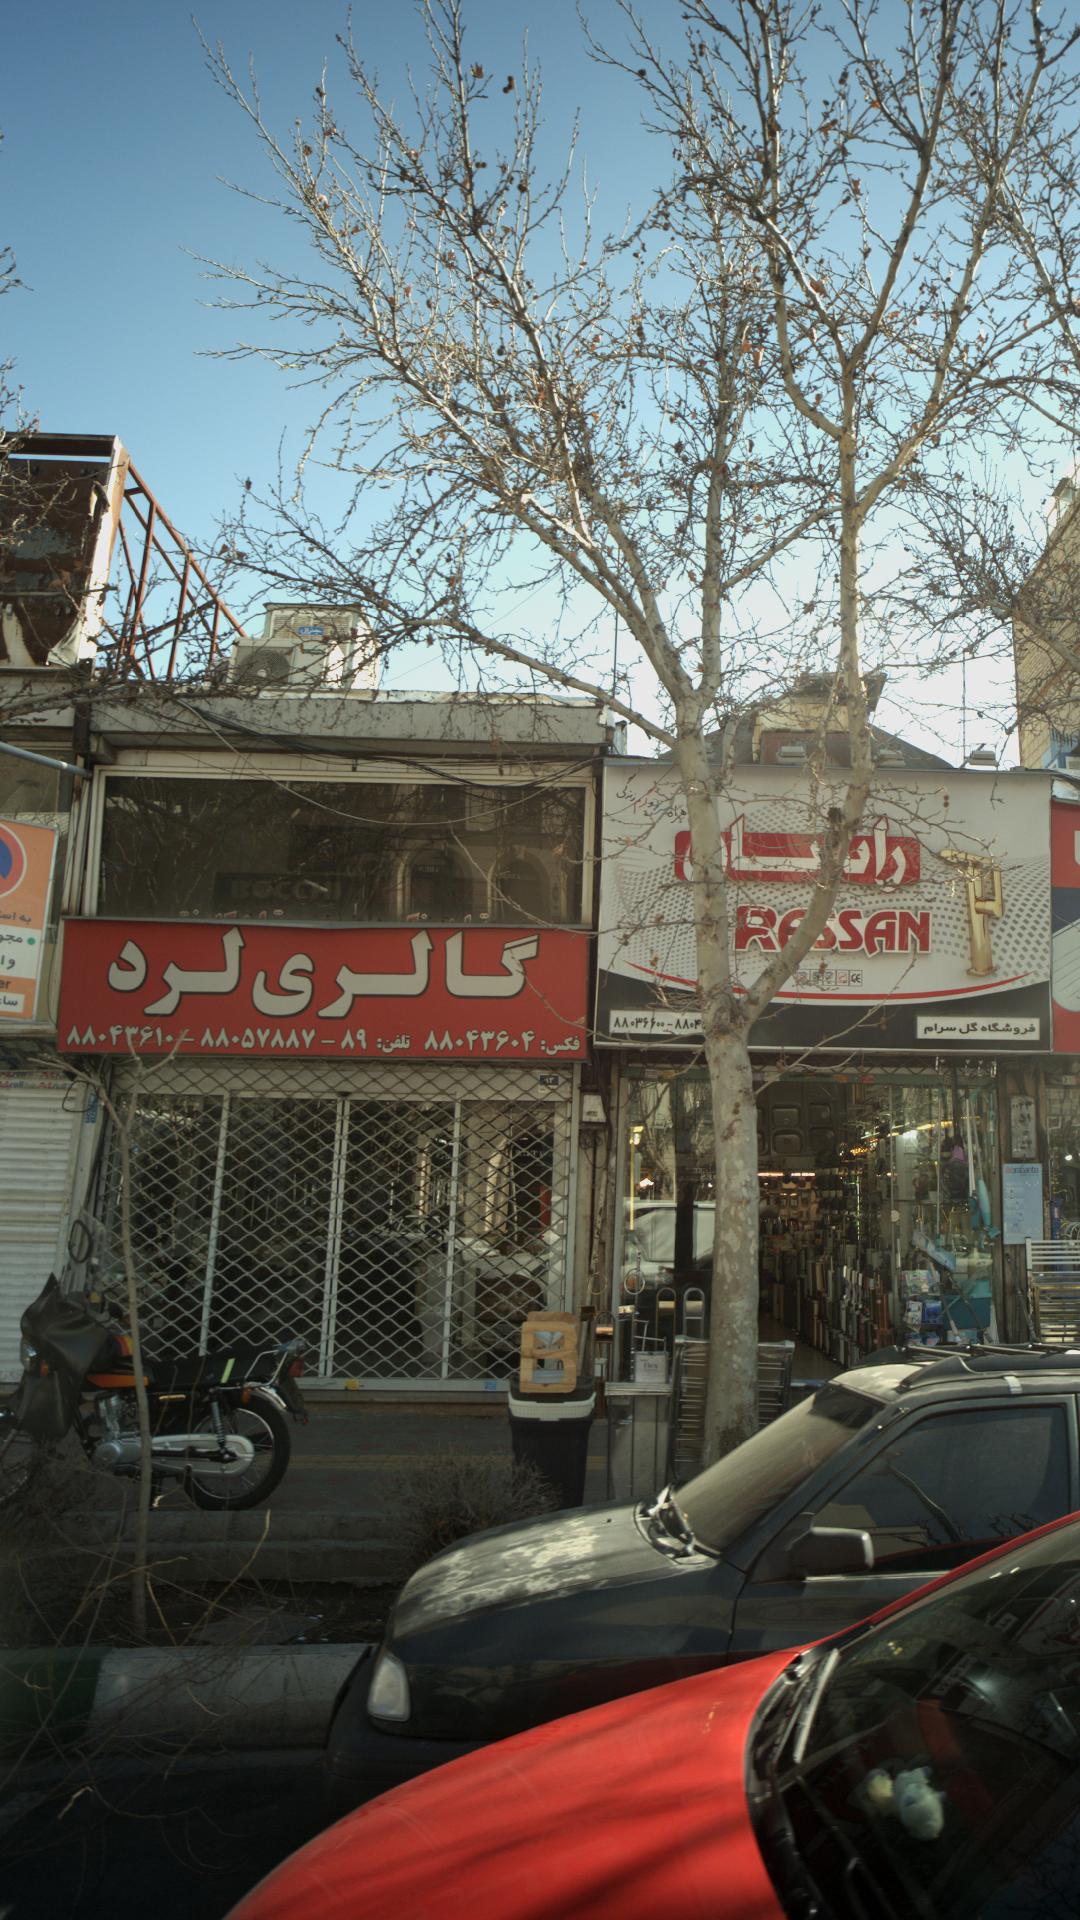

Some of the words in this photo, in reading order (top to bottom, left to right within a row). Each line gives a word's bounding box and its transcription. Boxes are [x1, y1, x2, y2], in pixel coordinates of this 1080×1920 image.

[108, 926, 246, 1016] لرد
[252, 929, 541, 1018] گالری
[200, 1027, 317, 1049] ۸۸۰۵۷۸۸۷
[958, 1022, 978, 1034] گل
[980, 1022, 1036, 1035] فروشگاه
[376, 1035, 411, 1053] تلفن:
[424, 1029, 535, 1052] ۸۸۰۴۳۶۰۴
[540, 1036, 581, 1055] فکس:
